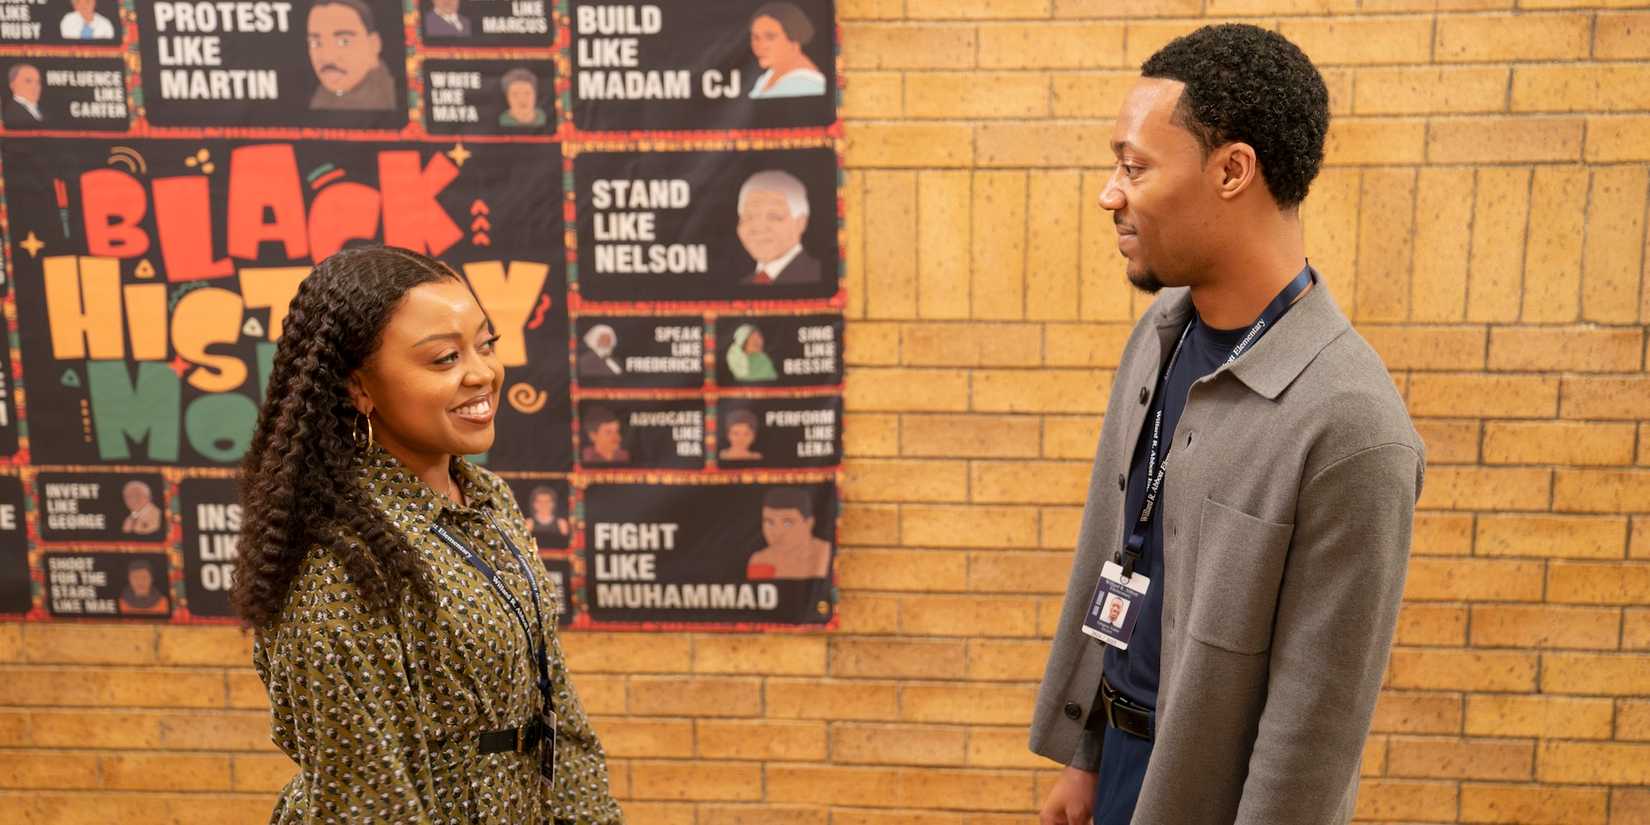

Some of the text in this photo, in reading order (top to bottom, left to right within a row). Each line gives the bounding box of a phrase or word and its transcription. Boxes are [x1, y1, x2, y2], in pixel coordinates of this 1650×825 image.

[0, 5, 30, 21] LIKE
[512, 0, 543, 16] LIKE
[154, 2, 291, 32] PROTEST
[483, 15, 547, 33] MARCUS
[578, 6, 661, 34] BUILD
[1, 22, 40, 39] RUBY
[158, 36, 221, 65] LIKE
[578, 39, 638, 67] LIKE
[47, 71, 122, 87] INFLUENCE
[161, 70, 277, 99] MARTIN
[431, 72, 480, 89] WRITE
[579, 70, 740, 99] MADAM CJ
[95, 86, 123, 104] LIKE
[432, 89, 463, 106] LIKE
[70, 103, 126, 118] CARTER
[433, 105, 478, 121] MAYA
[592, 180, 690, 208] STAND
[81, 144, 464, 281] BLACK
[594, 212, 655, 240] LIKE
[595, 244, 707, 273] NELSON
[655, 327, 701, 342] SPEAK
[798, 326, 834, 343] SING
[1233, 318, 1266, 357] Elementary
[672, 342, 701, 356] LIKE
[804, 342, 835, 357] LIKE
[626, 356, 701, 372] FREDERICK
[784, 357, 834, 374] BESSIE
[630, 411, 702, 427] ADVOCATE
[766, 410, 835, 426] PERFORM
[673, 427, 702, 441] LIKE
[805, 425, 833, 440] LIKE
[677, 441, 701, 456] IDA
[797, 441, 833, 456] LENA
[46, 484, 99, 499] INVENT
[47, 498, 77, 513] LIKE
[48, 513, 104, 529] GEORGE
[595, 523, 677, 550] FIGHT
[199, 535, 239, 560] LIK
[49, 557, 93, 570] SHOOT
[596, 554, 655, 580] LIKE
[51, 571, 106, 587] FOR THE
[52, 586, 96, 600] STARS
[597, 584, 777, 609] MUHAMMAD
[53, 599, 115, 613] LIKE MAE
